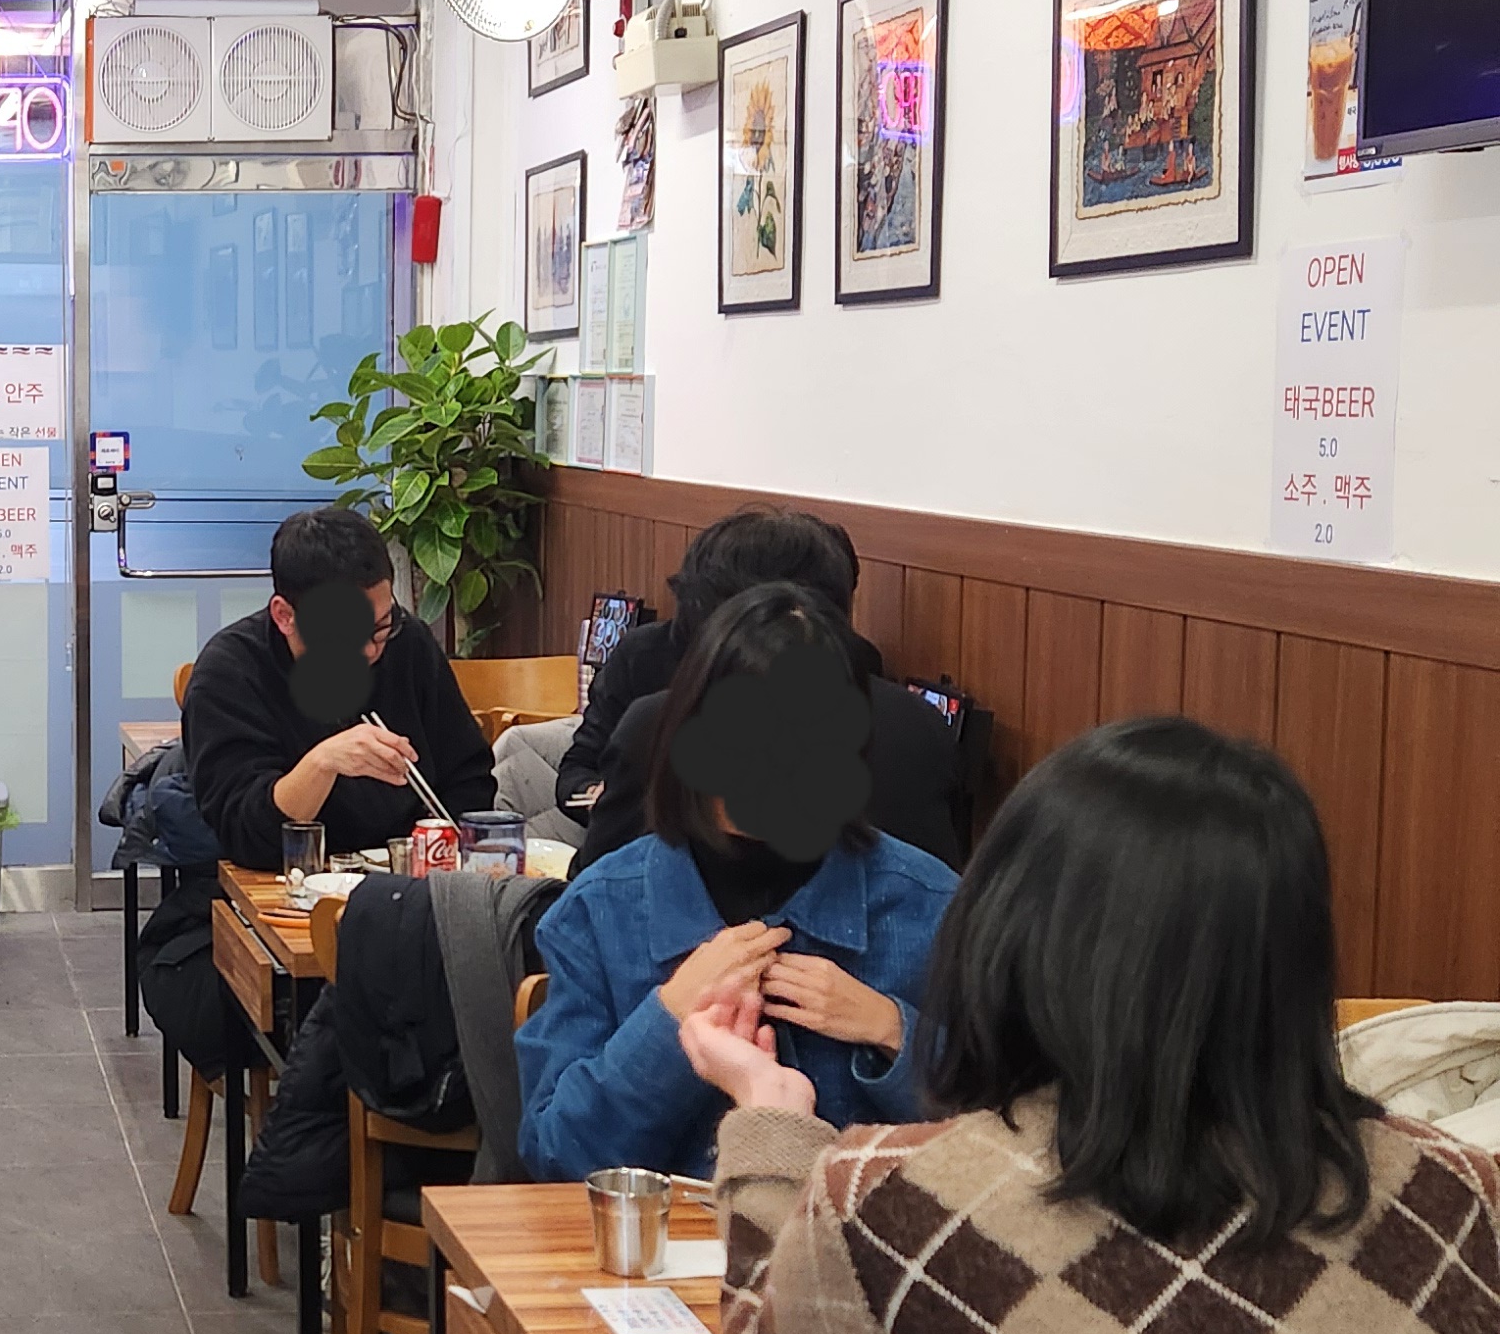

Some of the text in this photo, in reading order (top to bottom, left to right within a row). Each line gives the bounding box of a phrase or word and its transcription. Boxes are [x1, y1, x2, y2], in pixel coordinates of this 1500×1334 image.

[1307, 252, 1365, 288] OPEN
[1300, 309, 1371, 342] EVENT
[5, 383, 44, 404] 안주
[1284, 385, 1375, 420] 태국BEER
[9, 427, 31, 438] 작은
[35, 427, 57, 438] 선물
[1318, 437, 1338, 458] 5.0
[1284, 473, 1318, 506] 소주
[1334, 474, 1372, 510] 맥주
[1314, 522, 1333, 544] 2.0
[10, 544, 37, 559] 맥주
